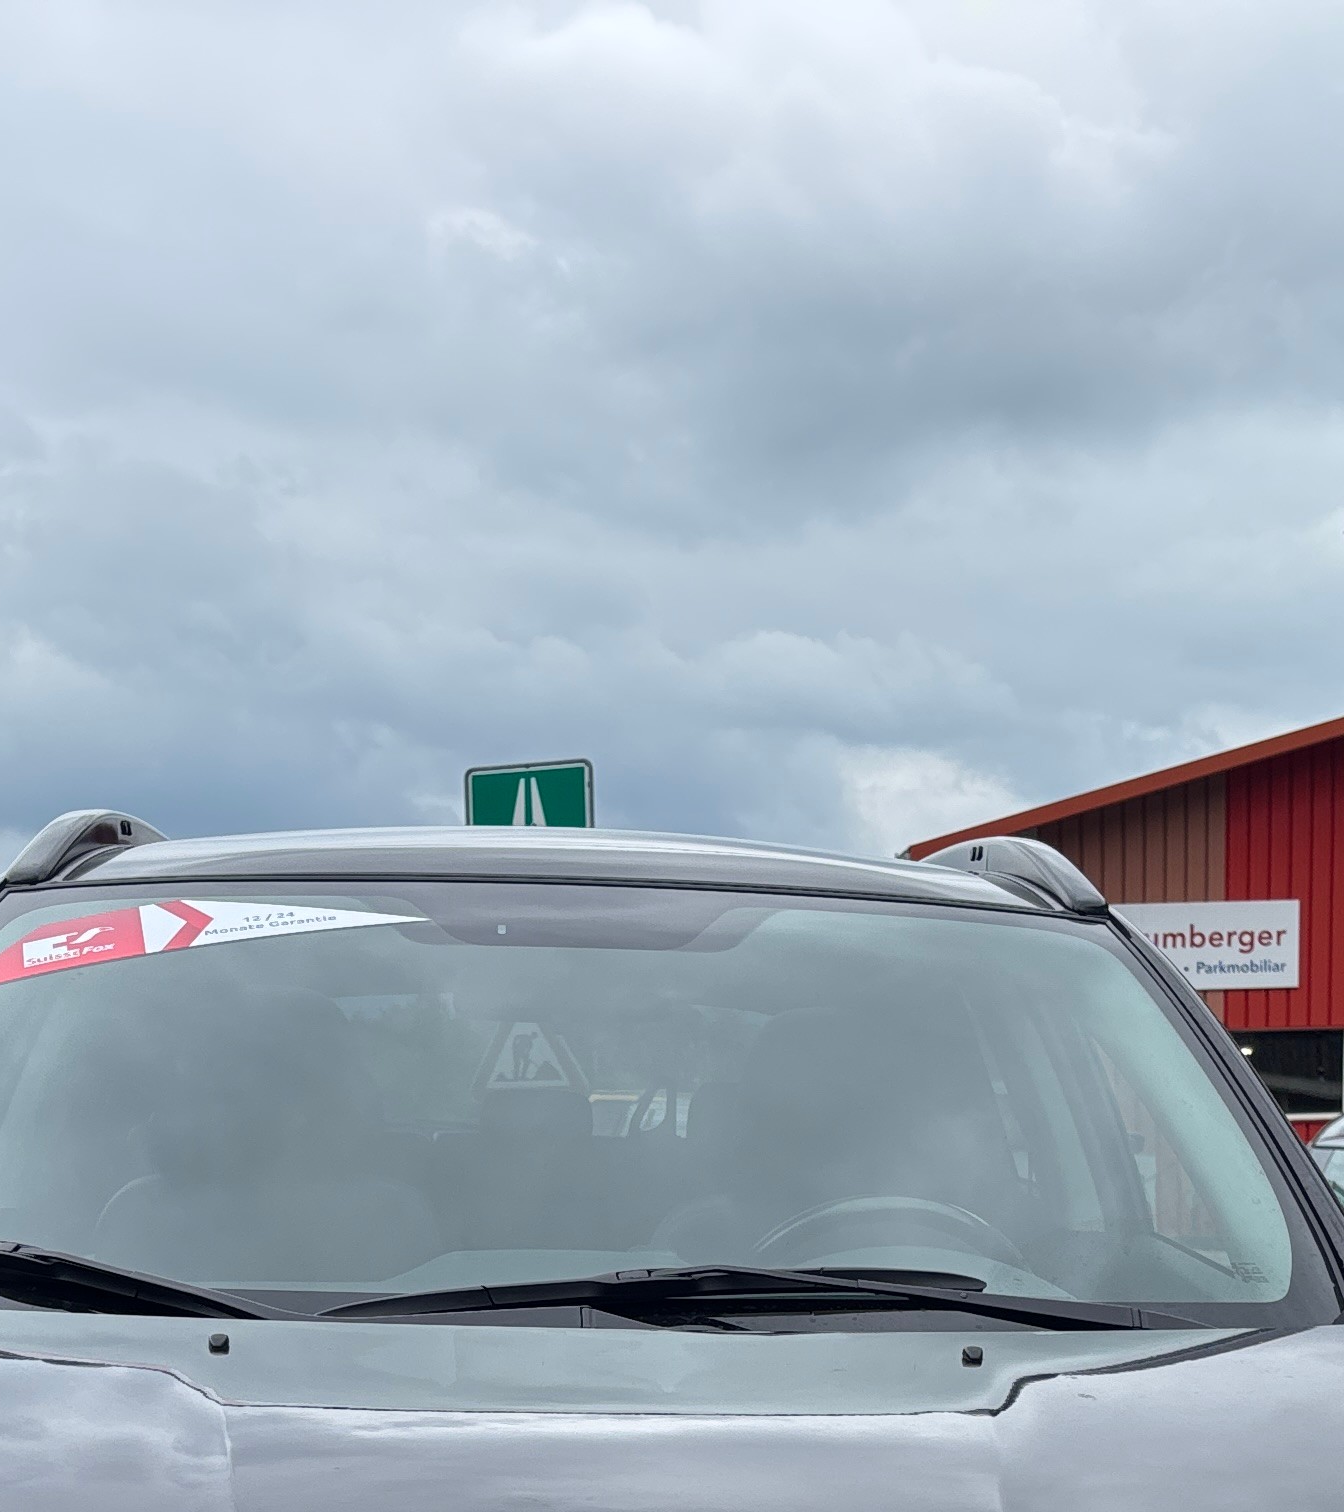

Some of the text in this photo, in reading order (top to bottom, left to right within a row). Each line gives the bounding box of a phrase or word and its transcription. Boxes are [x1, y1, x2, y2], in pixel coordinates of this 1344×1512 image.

[243, 915, 261, 923] 12
[277, 911, 296, 919] 24
[204, 915, 338, 936] Monate Garantie
[81, 942, 116, 955] Fox
[1195, 958, 1288, 975] Parkmobiliar
